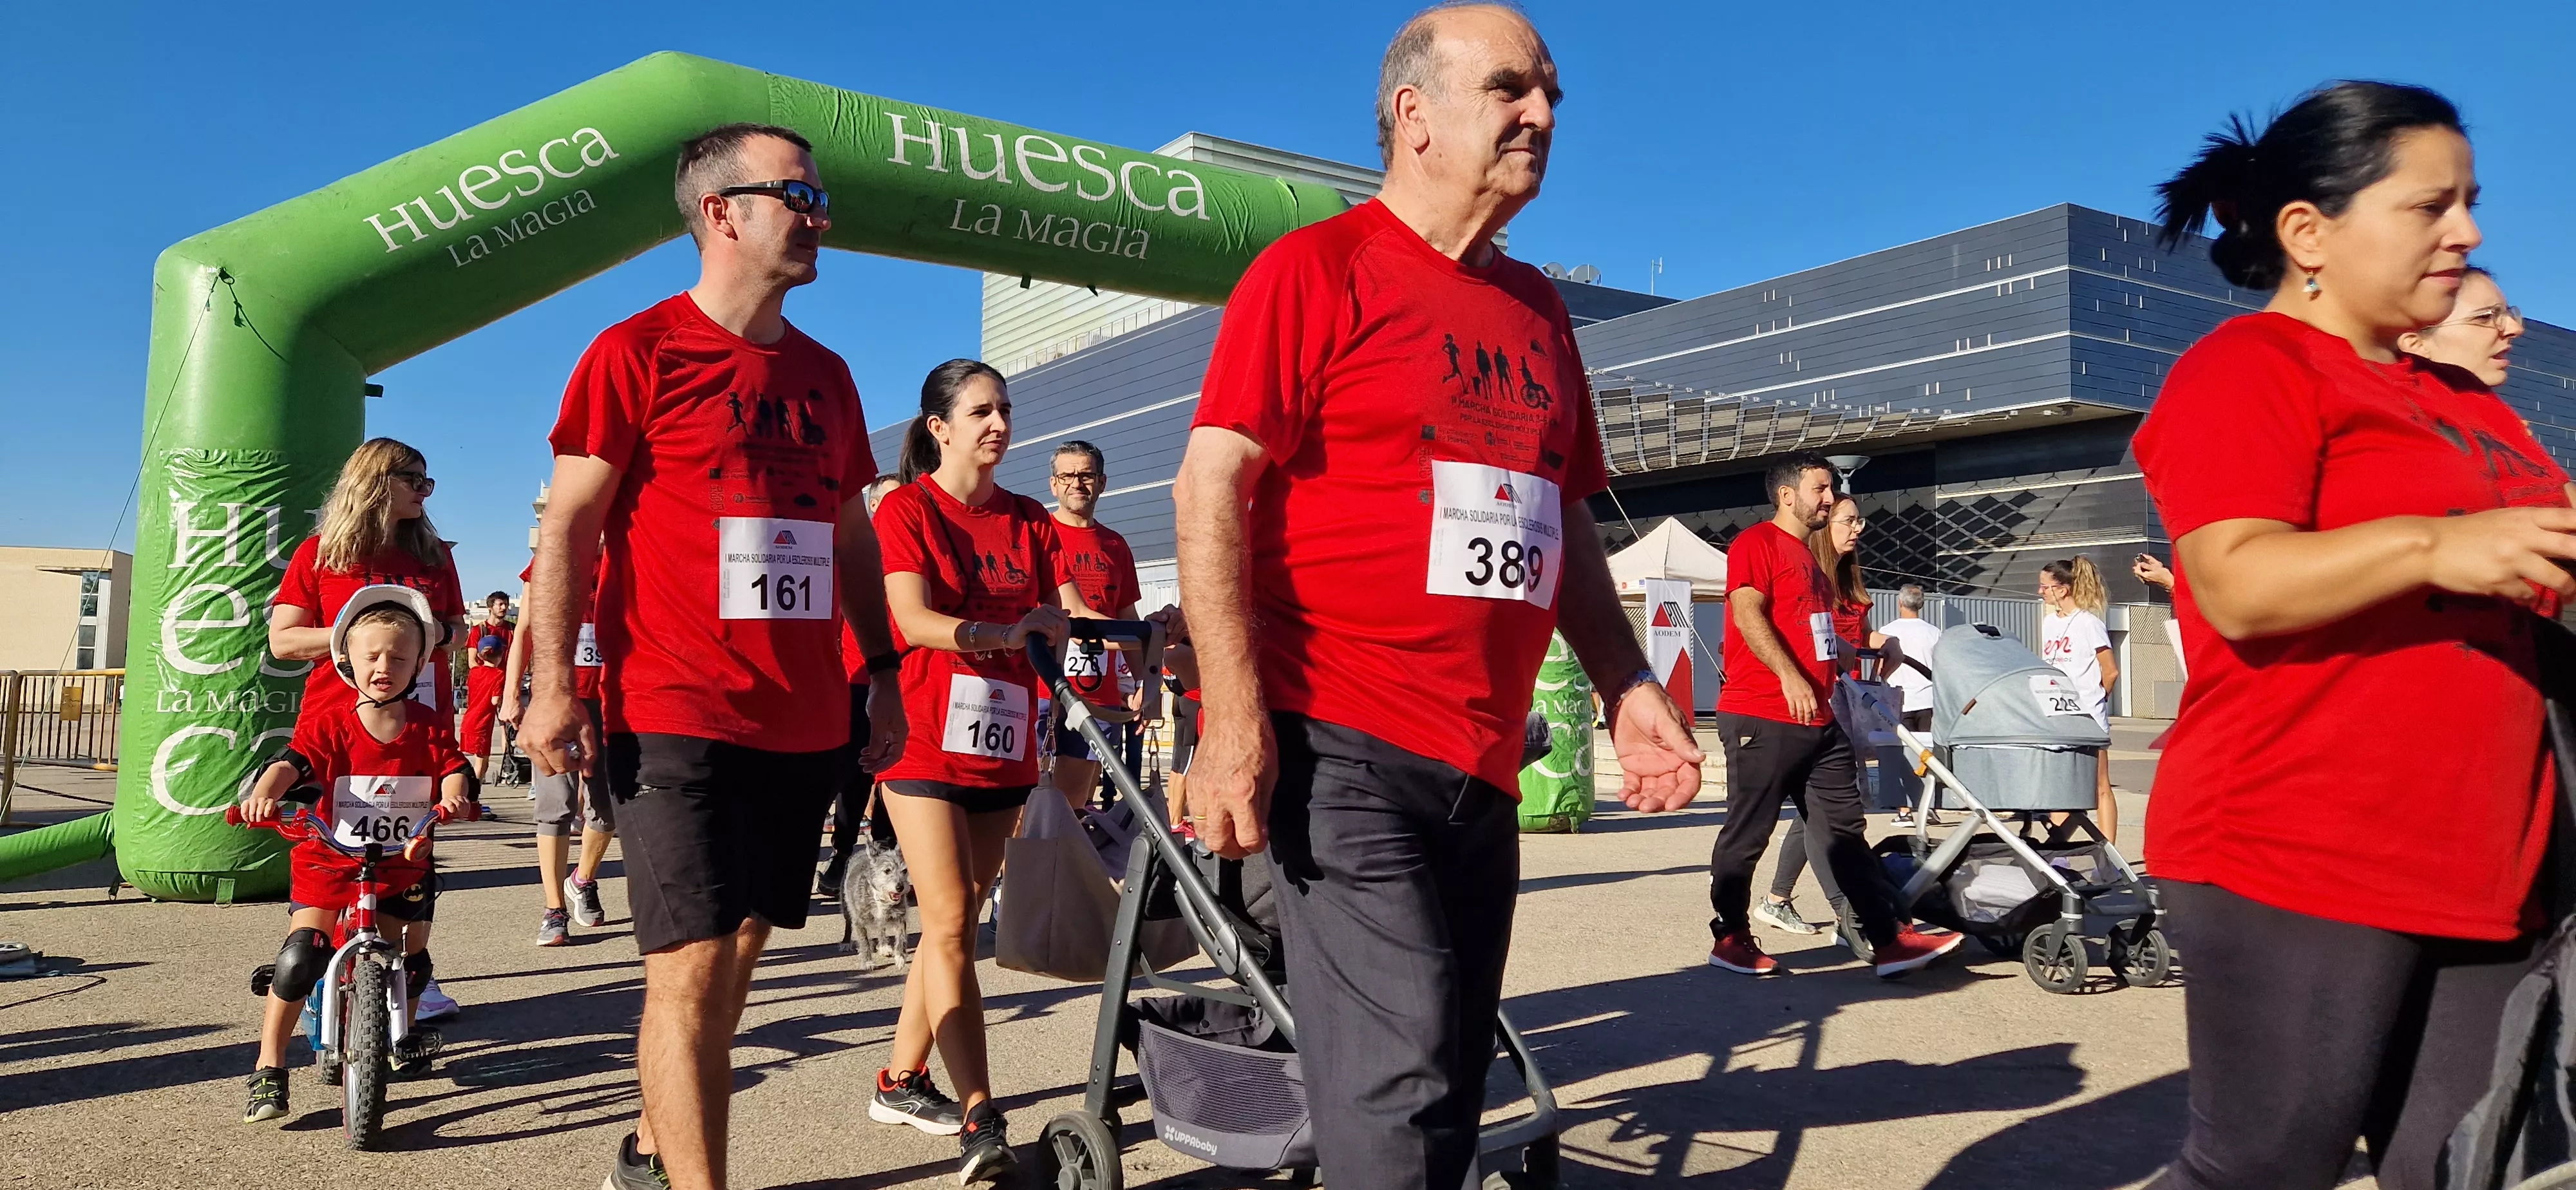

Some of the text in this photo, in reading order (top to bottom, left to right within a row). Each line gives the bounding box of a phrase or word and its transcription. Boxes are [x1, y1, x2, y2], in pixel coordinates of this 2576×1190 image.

[1443, 507, 1468, 521] MARCHA
[1469, 510, 1499, 524] SOLIDARIA
[1499, 515, 1511, 525] POR
[1511, 515, 1517, 527] LA
[1518, 516, 1543, 534] ESCLEROSIS
[728, 554, 750, 563] MARCHA
[751, 554, 776, 563] SOLIDARIA
[777, 554, 786, 564] POR
[1465, 537, 1544, 593] 389
[752, 574, 810, 611] 161
[954, 702, 971, 711] MARCHA
[2049, 697, 2081, 712] 229
[968, 720, 1015, 753] 160
[1089, 739, 1114, 778] CRUZ
[350, 815, 410, 842] 466
